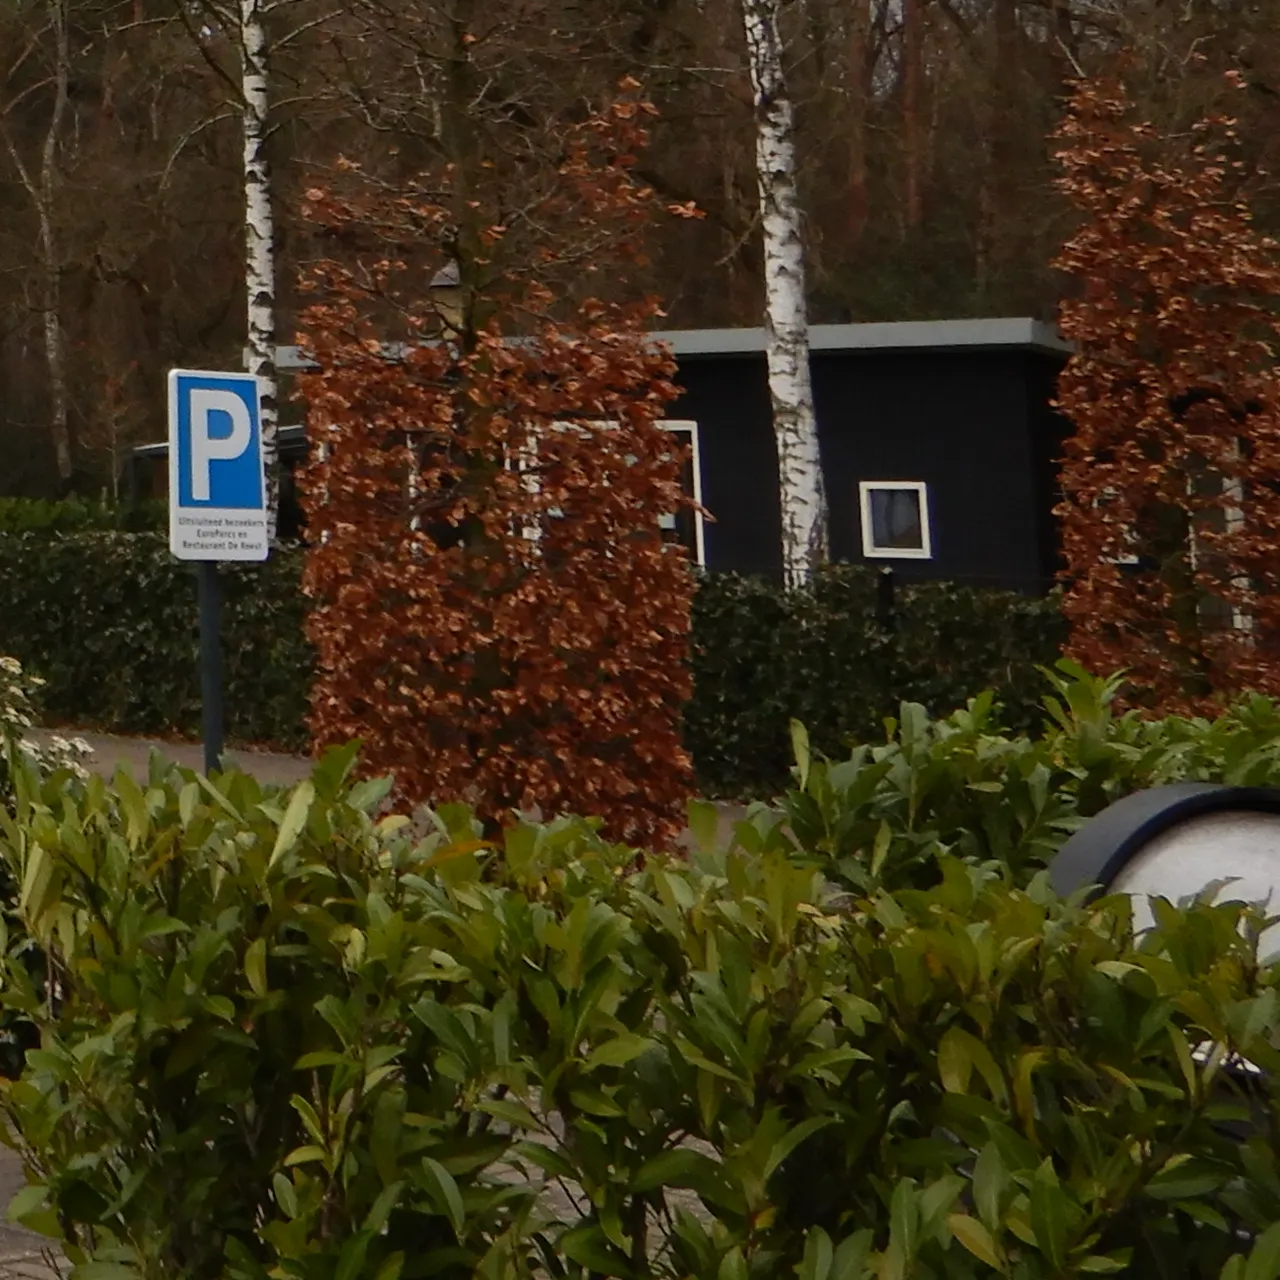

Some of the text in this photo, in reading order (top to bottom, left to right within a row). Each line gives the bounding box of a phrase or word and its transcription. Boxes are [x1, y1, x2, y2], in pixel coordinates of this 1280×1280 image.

[190, 389, 251, 500] P
[196, 528, 248, 539] EuroParcs en
[182, 540, 226, 550] Restaurant
